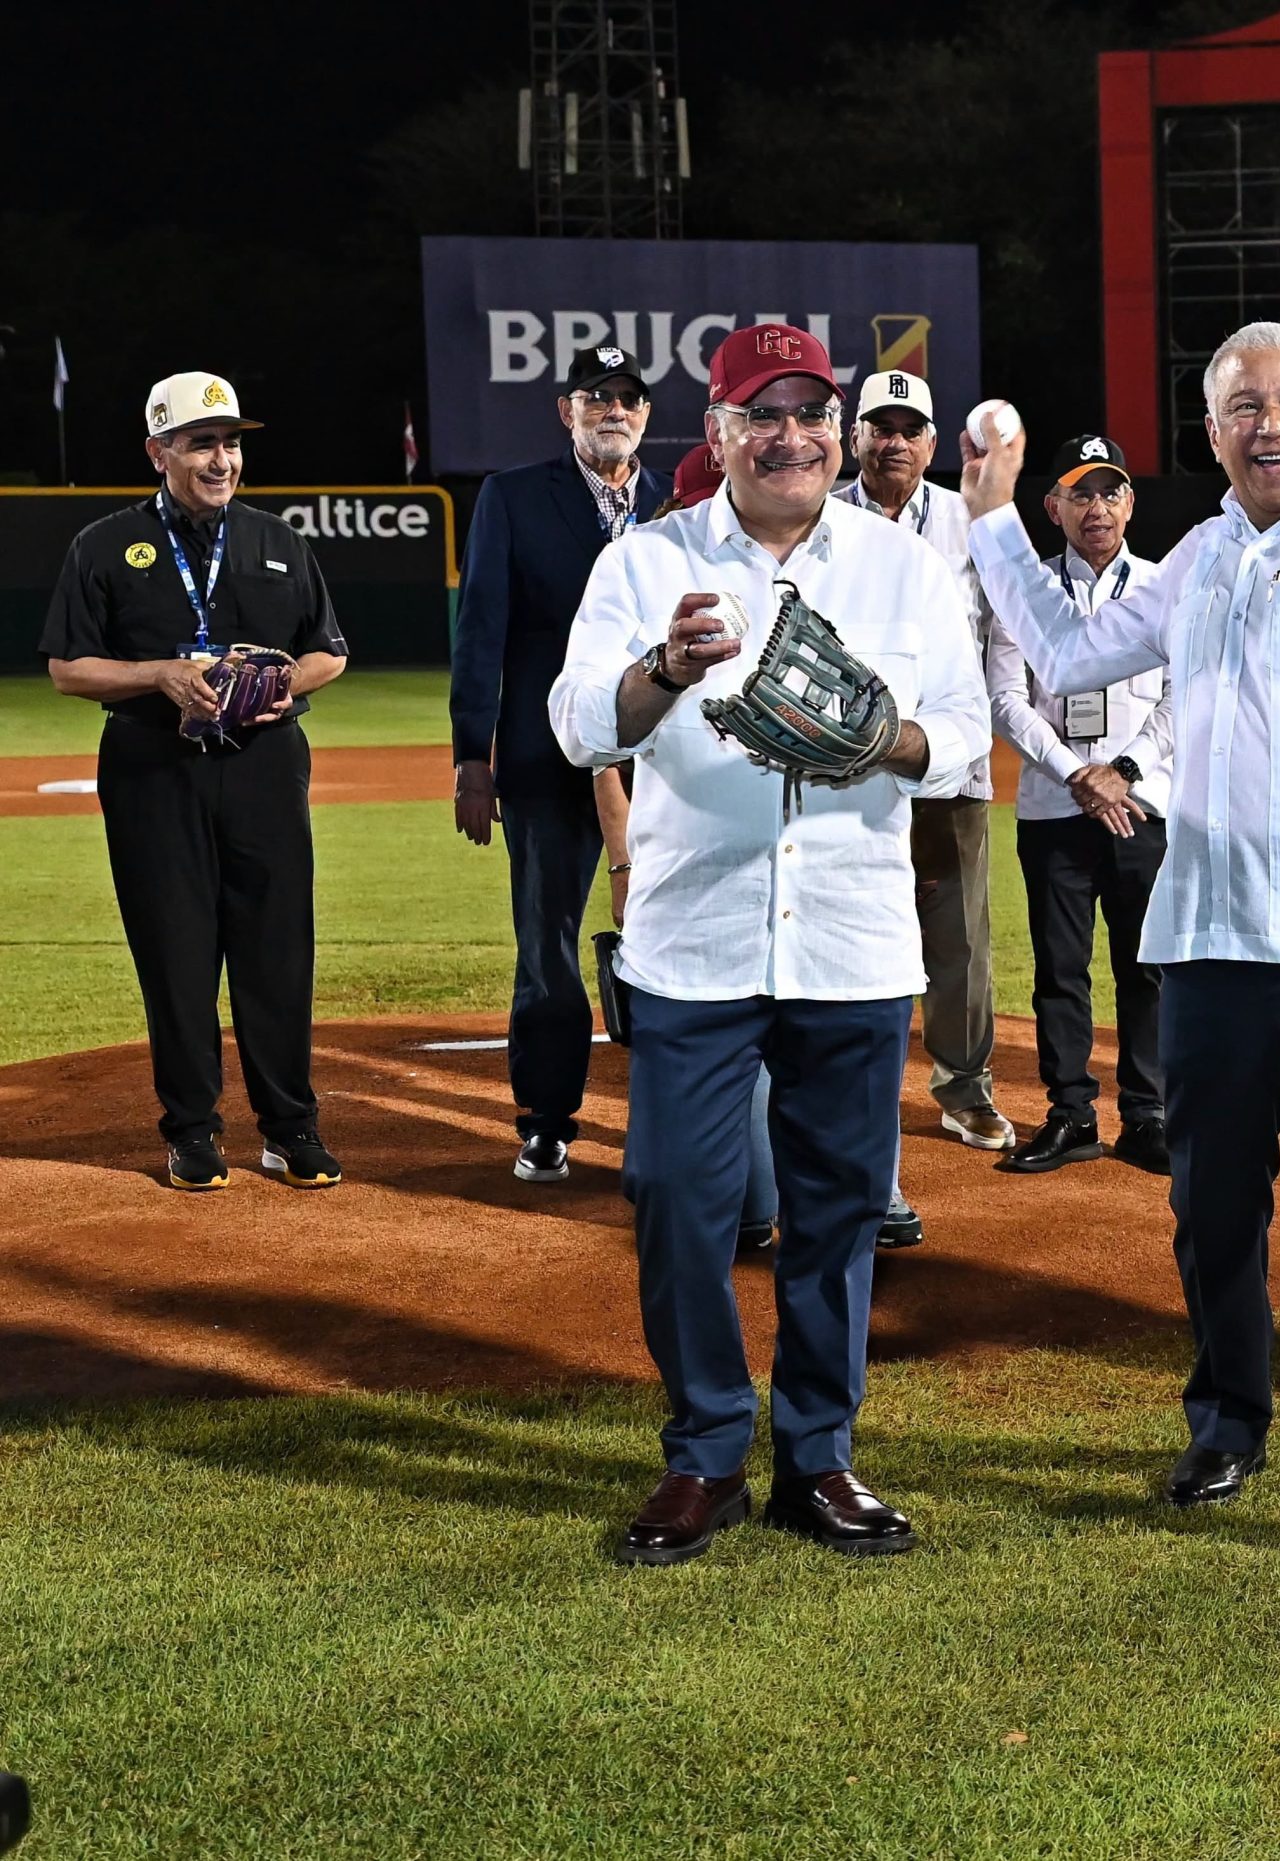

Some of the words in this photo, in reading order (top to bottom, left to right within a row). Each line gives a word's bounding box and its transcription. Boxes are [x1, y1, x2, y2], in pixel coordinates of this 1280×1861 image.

[488, 310, 857, 386] BRUGL
[281, 495, 430, 538] altice
[773, 703, 822, 739] A2000
